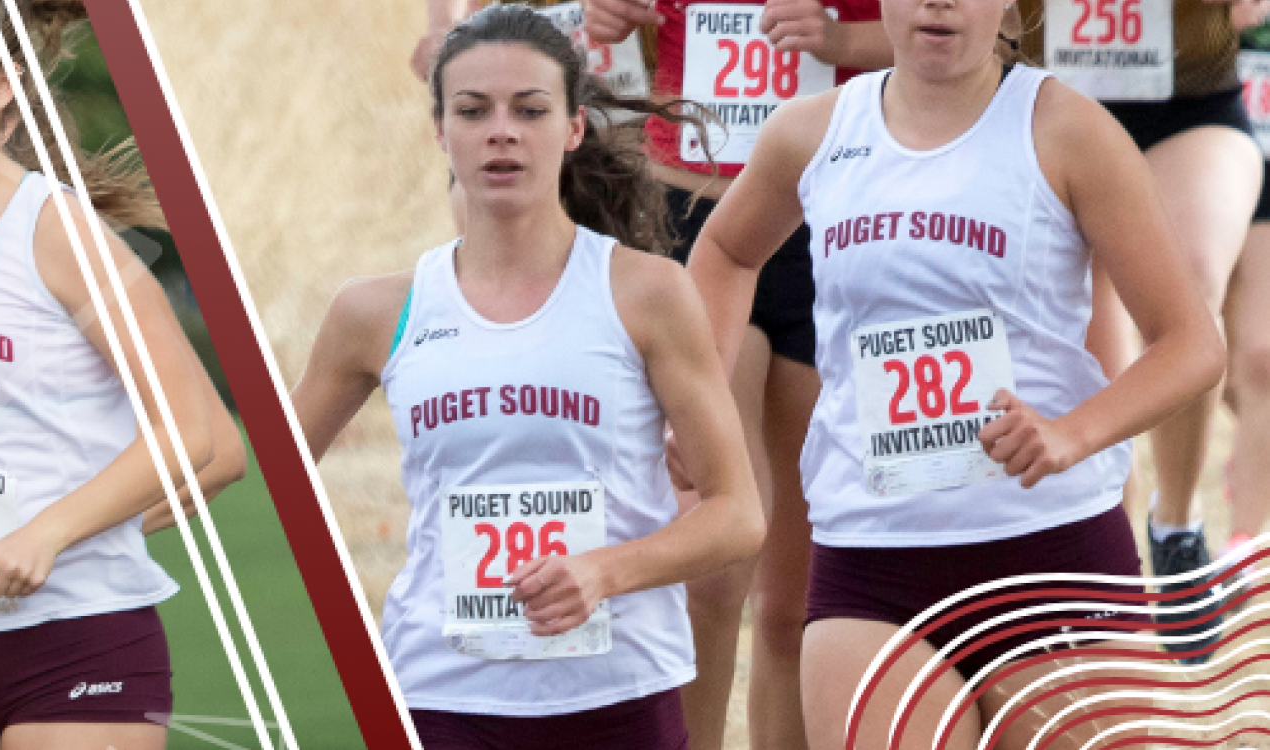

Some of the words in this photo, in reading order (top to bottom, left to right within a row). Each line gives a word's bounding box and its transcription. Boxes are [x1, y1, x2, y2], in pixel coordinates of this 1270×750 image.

[696, 12, 755, 35] PUGET
[1069, 0, 1144, 46] 256
[713, 38, 801, 100] 298
[824, 211, 905, 258] PUGET
[909, 210, 1007, 258] SOUND
[858, 328, 916, 359] PUGET
[922, 316, 995, 349] SOUND
[882, 349, 981, 425] 282
[410, 386, 491, 438] PUGET
[499, 384, 601, 428] SOUND
[870, 415, 1001, 457] INVITATION
[449, 493, 511, 518] PUGET
[520, 490, 593, 515] SOUND
[473, 519, 569, 589] 286
